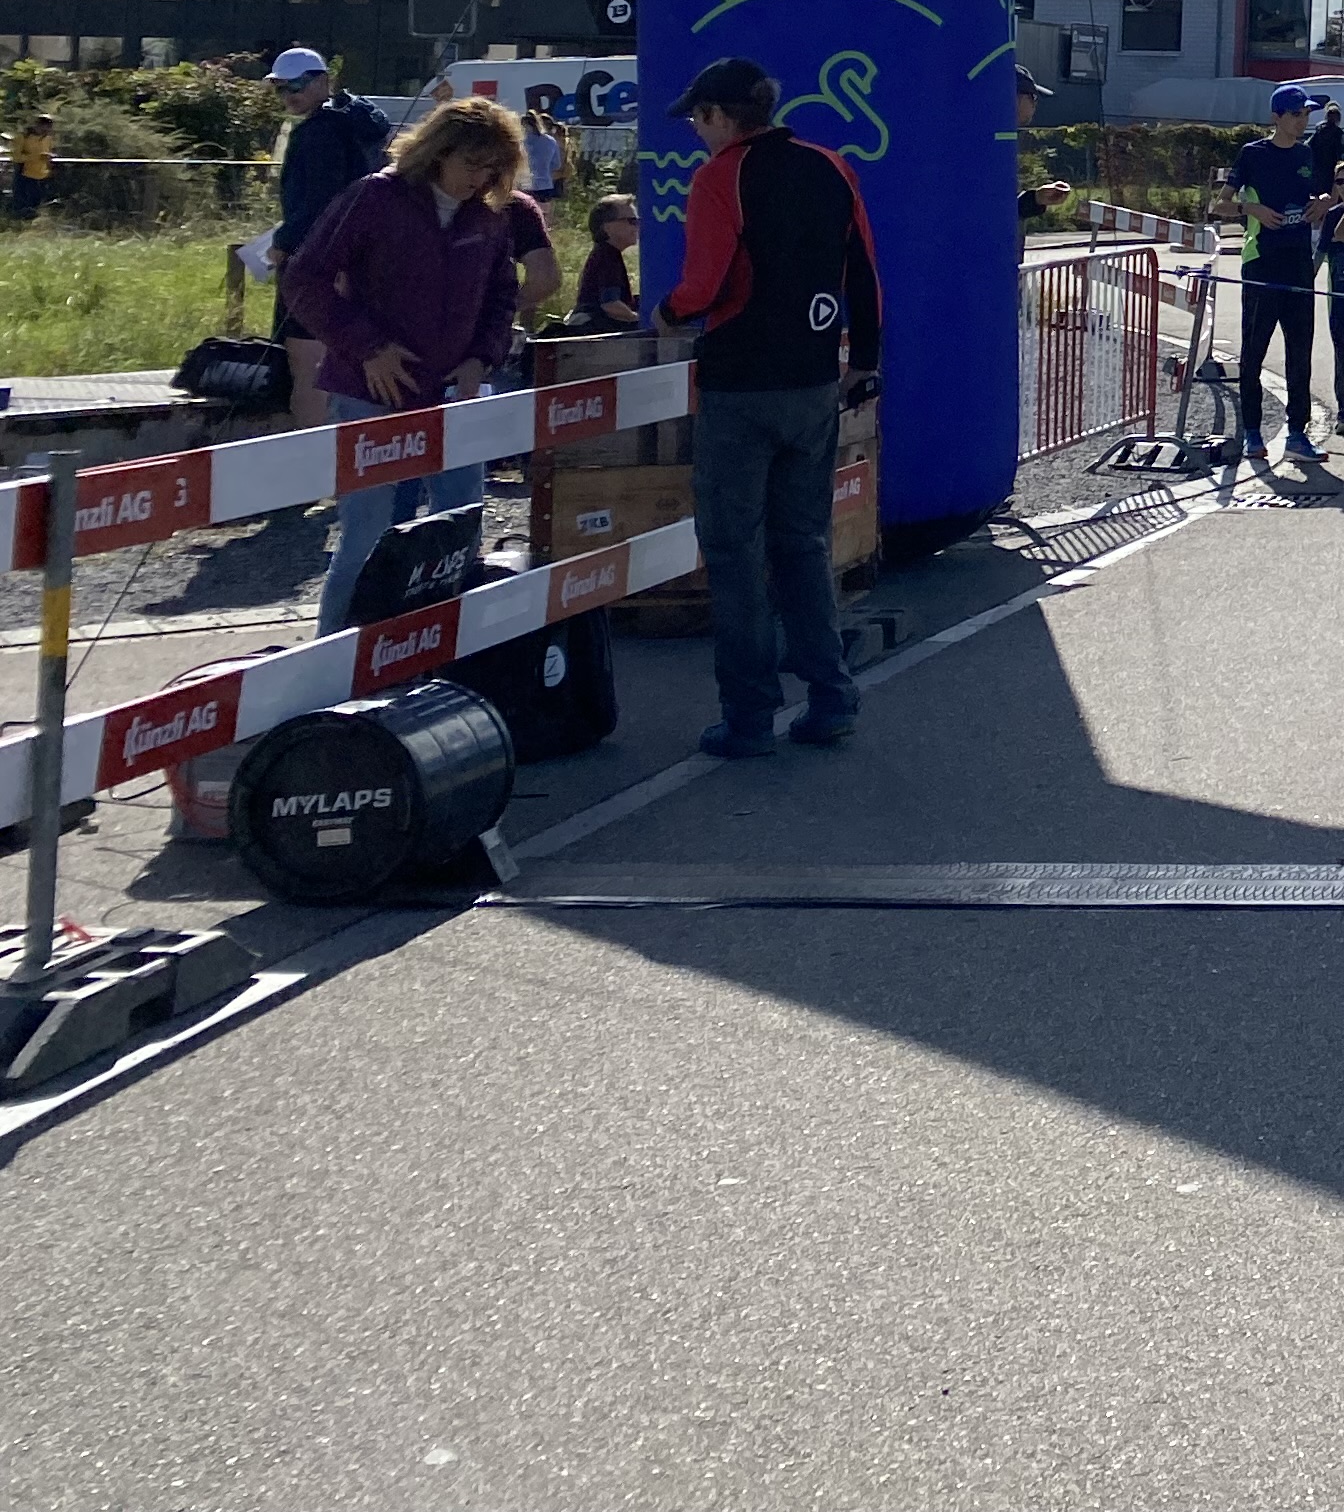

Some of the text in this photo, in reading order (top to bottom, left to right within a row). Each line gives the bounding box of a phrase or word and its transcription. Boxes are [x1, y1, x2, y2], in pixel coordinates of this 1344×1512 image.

[585, 396, 603, 418] AG
[402, 431, 426, 457] AG
[76, 499, 113, 532] nzli
[116, 491, 152, 522] AG
[418, 624, 441, 653] AG
[186, 701, 218, 733] AG
[271, 788, 393, 819] MYLAPS
